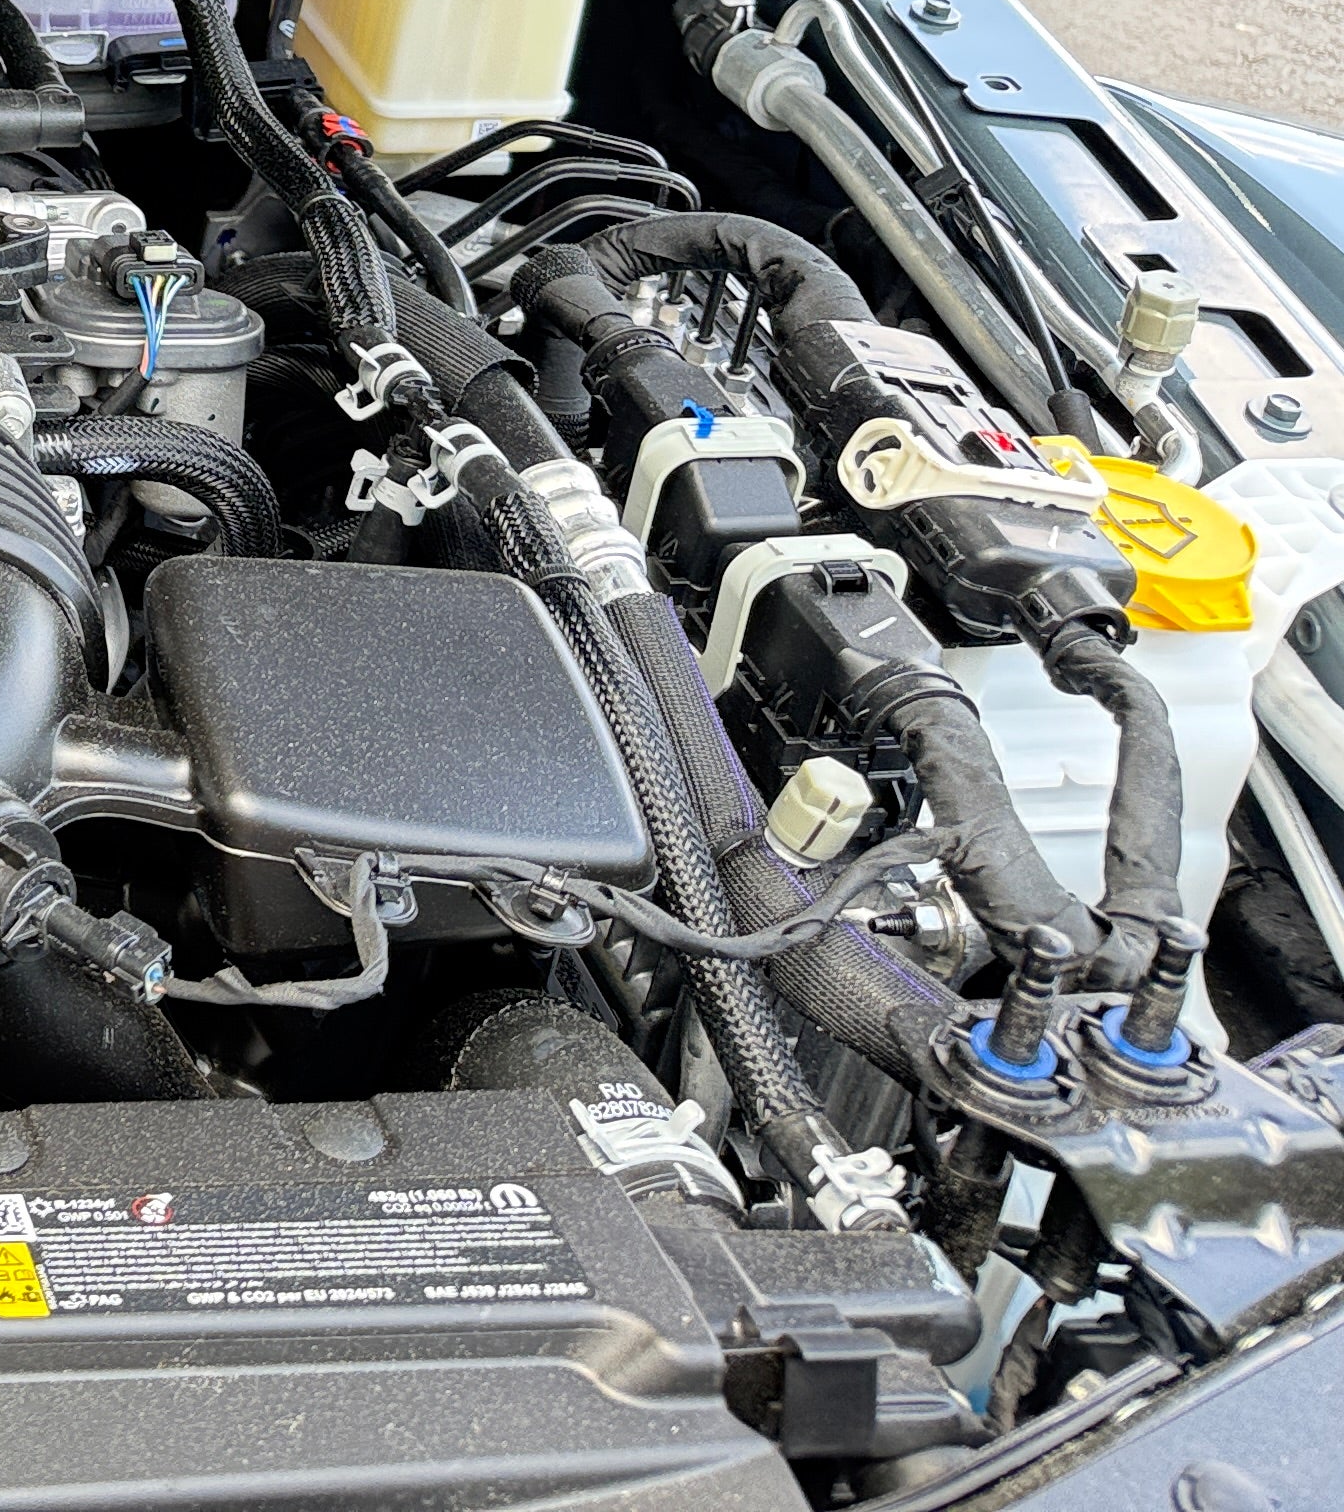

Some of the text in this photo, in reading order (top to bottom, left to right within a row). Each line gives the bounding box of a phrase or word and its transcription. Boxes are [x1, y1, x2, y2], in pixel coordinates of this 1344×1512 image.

[598, 1082, 644, 1100] RAD
[381, 1202, 414, 1214] CO2
[56, 1210, 92, 1223] GWP
[186, 1292, 225, 1305] GWP
[241, 1290, 276, 1304] CO2
[303, 1288, 328, 1302] EU
[423, 1284, 459, 1299] SAE
[88, 1293, 124, 1307] PAG
